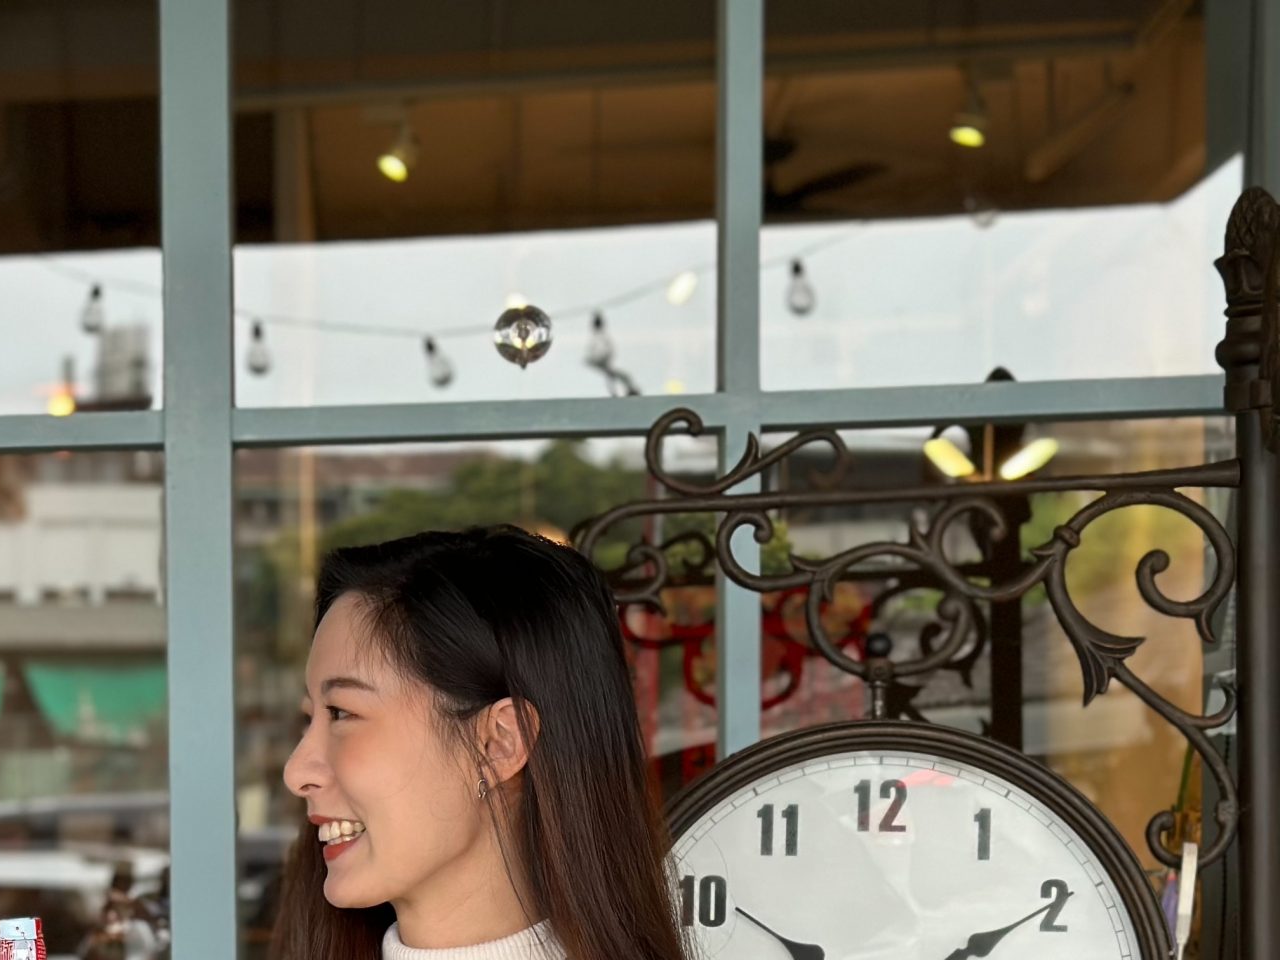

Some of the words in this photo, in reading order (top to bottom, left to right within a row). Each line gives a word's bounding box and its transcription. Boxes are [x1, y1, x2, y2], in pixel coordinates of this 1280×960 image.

[756, 804, 799, 856] 11
[853, 779, 908, 832] 12
[973, 808, 991, 860] 1
[677, 874, 727, 927] 10
[1039, 879, 1069, 932] 2
